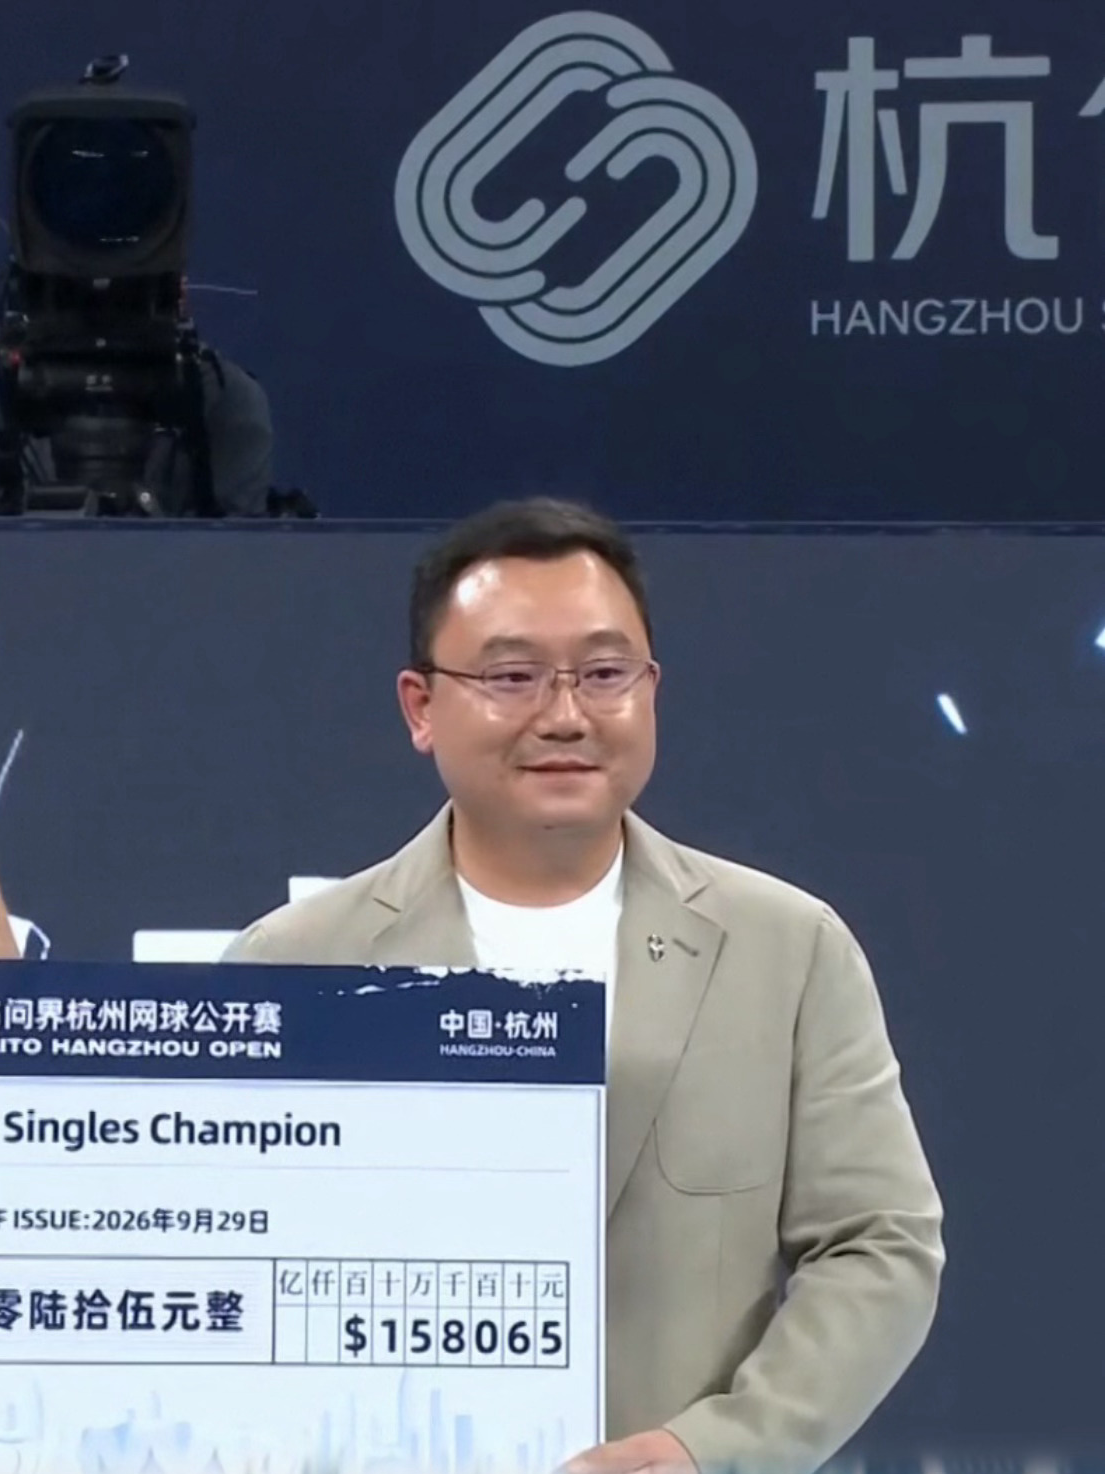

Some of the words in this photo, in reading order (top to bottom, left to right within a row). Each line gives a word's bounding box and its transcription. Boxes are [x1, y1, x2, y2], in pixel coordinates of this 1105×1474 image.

[812, 35, 1105, 261] 杭
[811, 297, 1083, 336] HANGZHOU
[440, 1009, 558, 1039] 中国·杭州
[53, 1039, 201, 1057] HANGZHOU
[209, 1041, 282, 1059] OPEN
[4, 1109, 139, 1152] Singles
[150, 1111, 343, 1153] Champion
[343, 1313, 563, 1358] $158065
